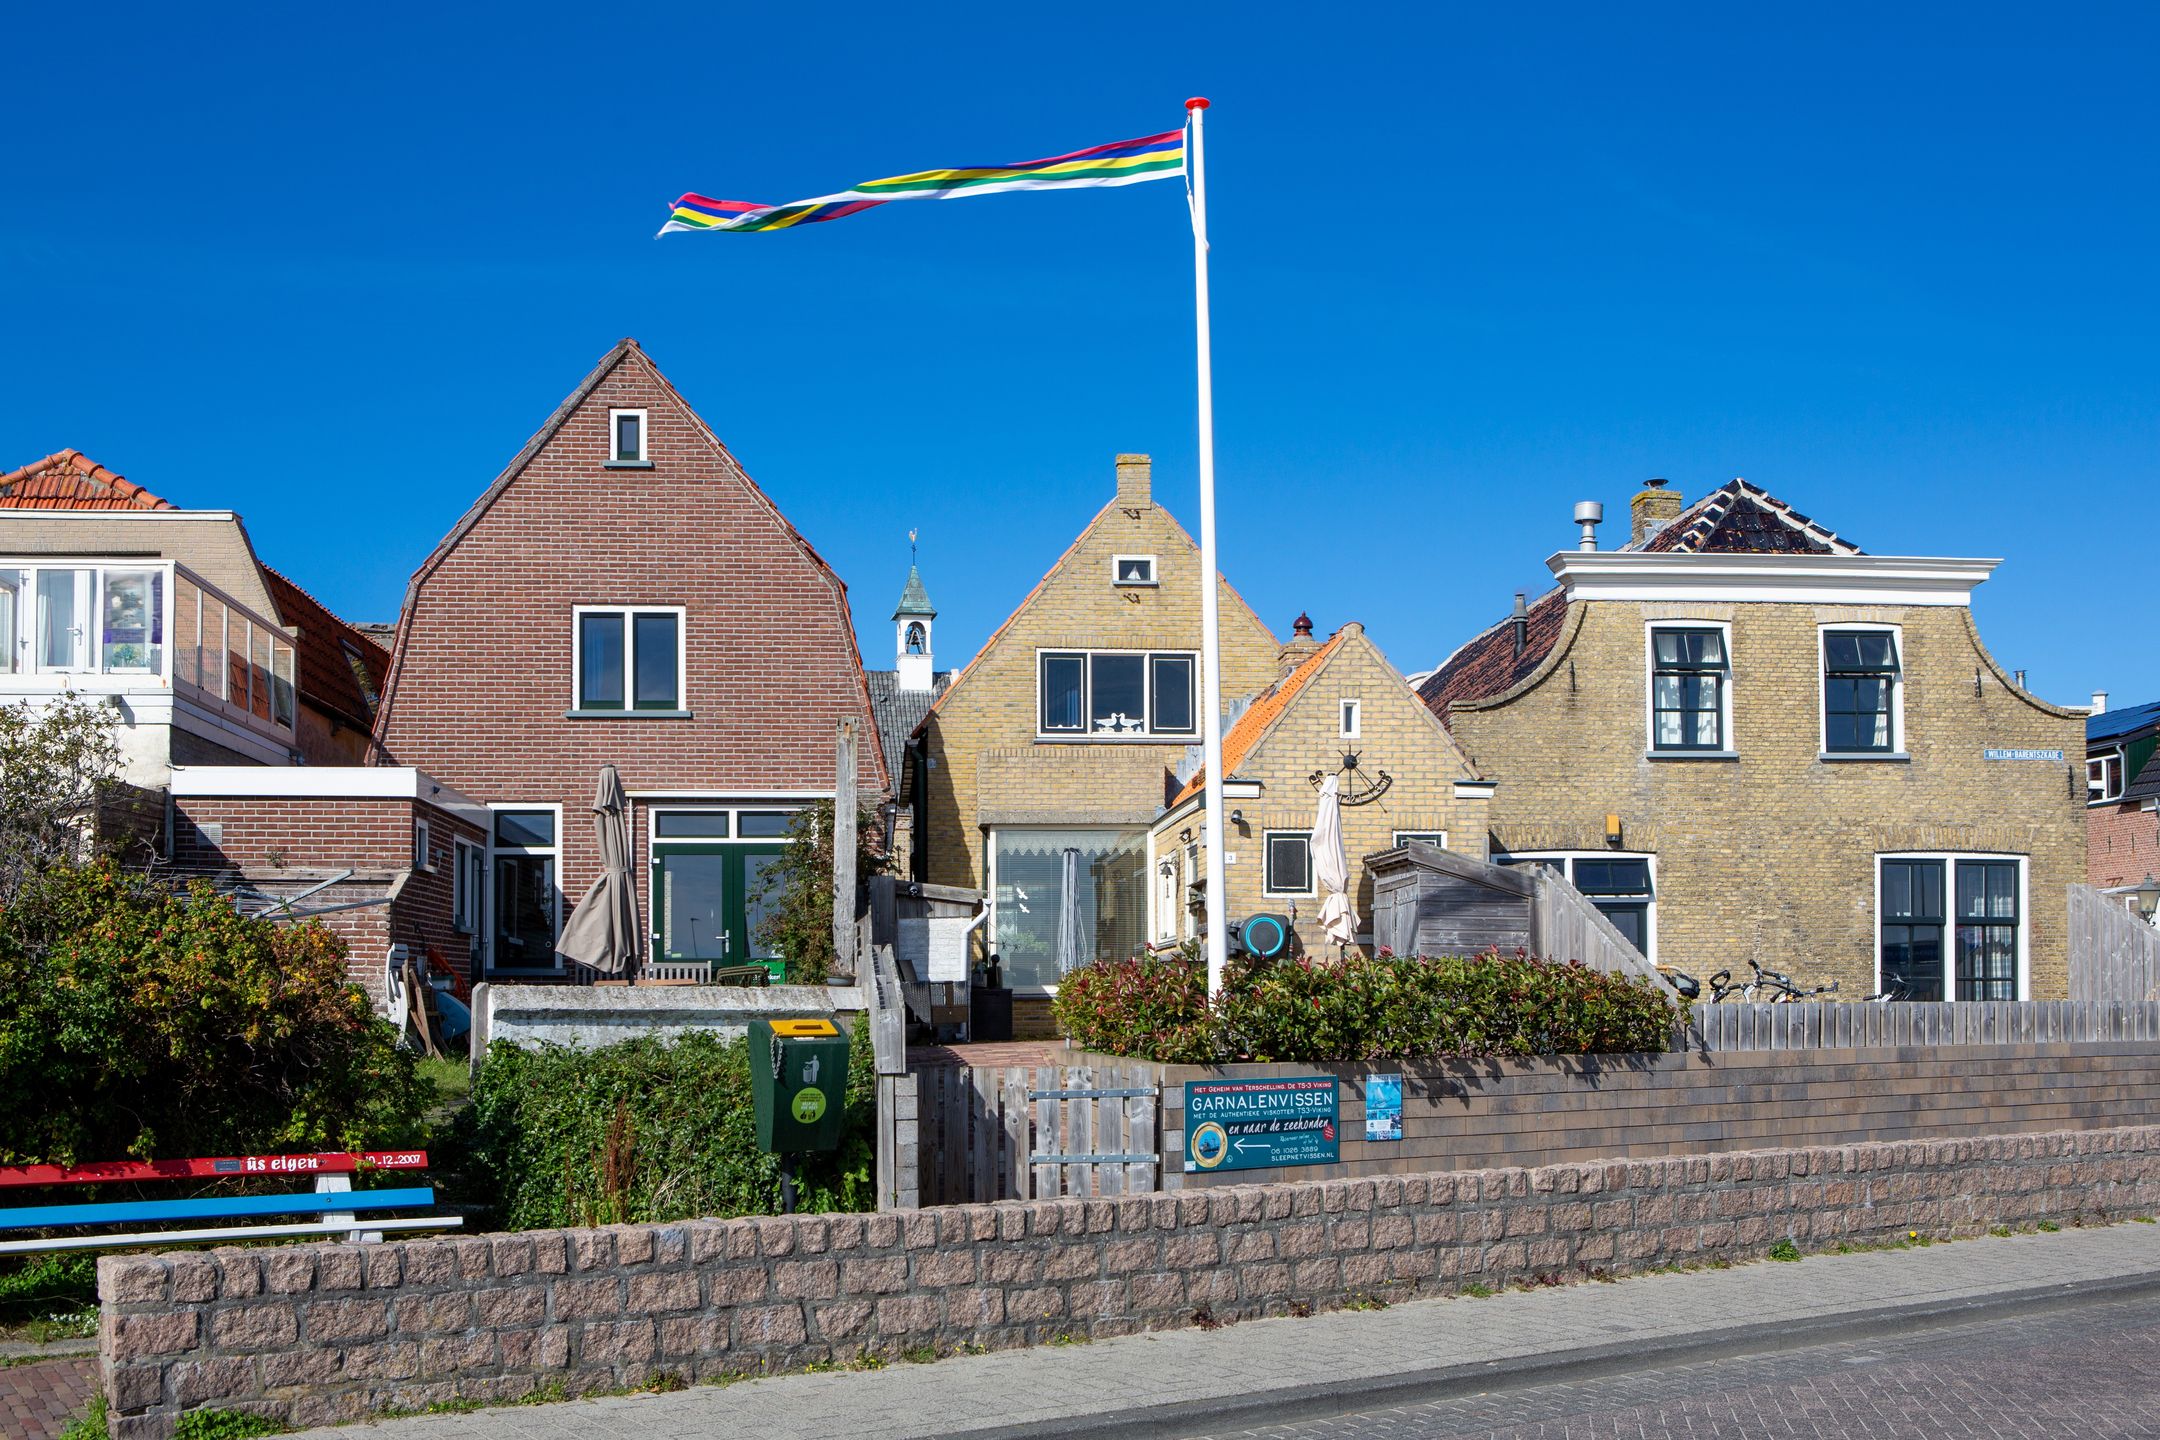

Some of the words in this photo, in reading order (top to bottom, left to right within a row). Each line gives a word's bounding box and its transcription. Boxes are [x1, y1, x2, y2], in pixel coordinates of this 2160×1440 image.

[1192, 1092, 1333, 1111] GARNALENVISSEN
[1220, 1110, 1260, 1118] AUTHENTIEKE
[1229, 1125, 1239, 1135] en
[1243, 1123, 1266, 1134] naar
[1269, 1117, 1280, 1131] de
[1283, 1114, 1329, 1131] zeehonden
[271, 1155, 318, 1171] eigen
[1271, 1152, 1334, 1161] SLEEPNETVISSEN.NL
